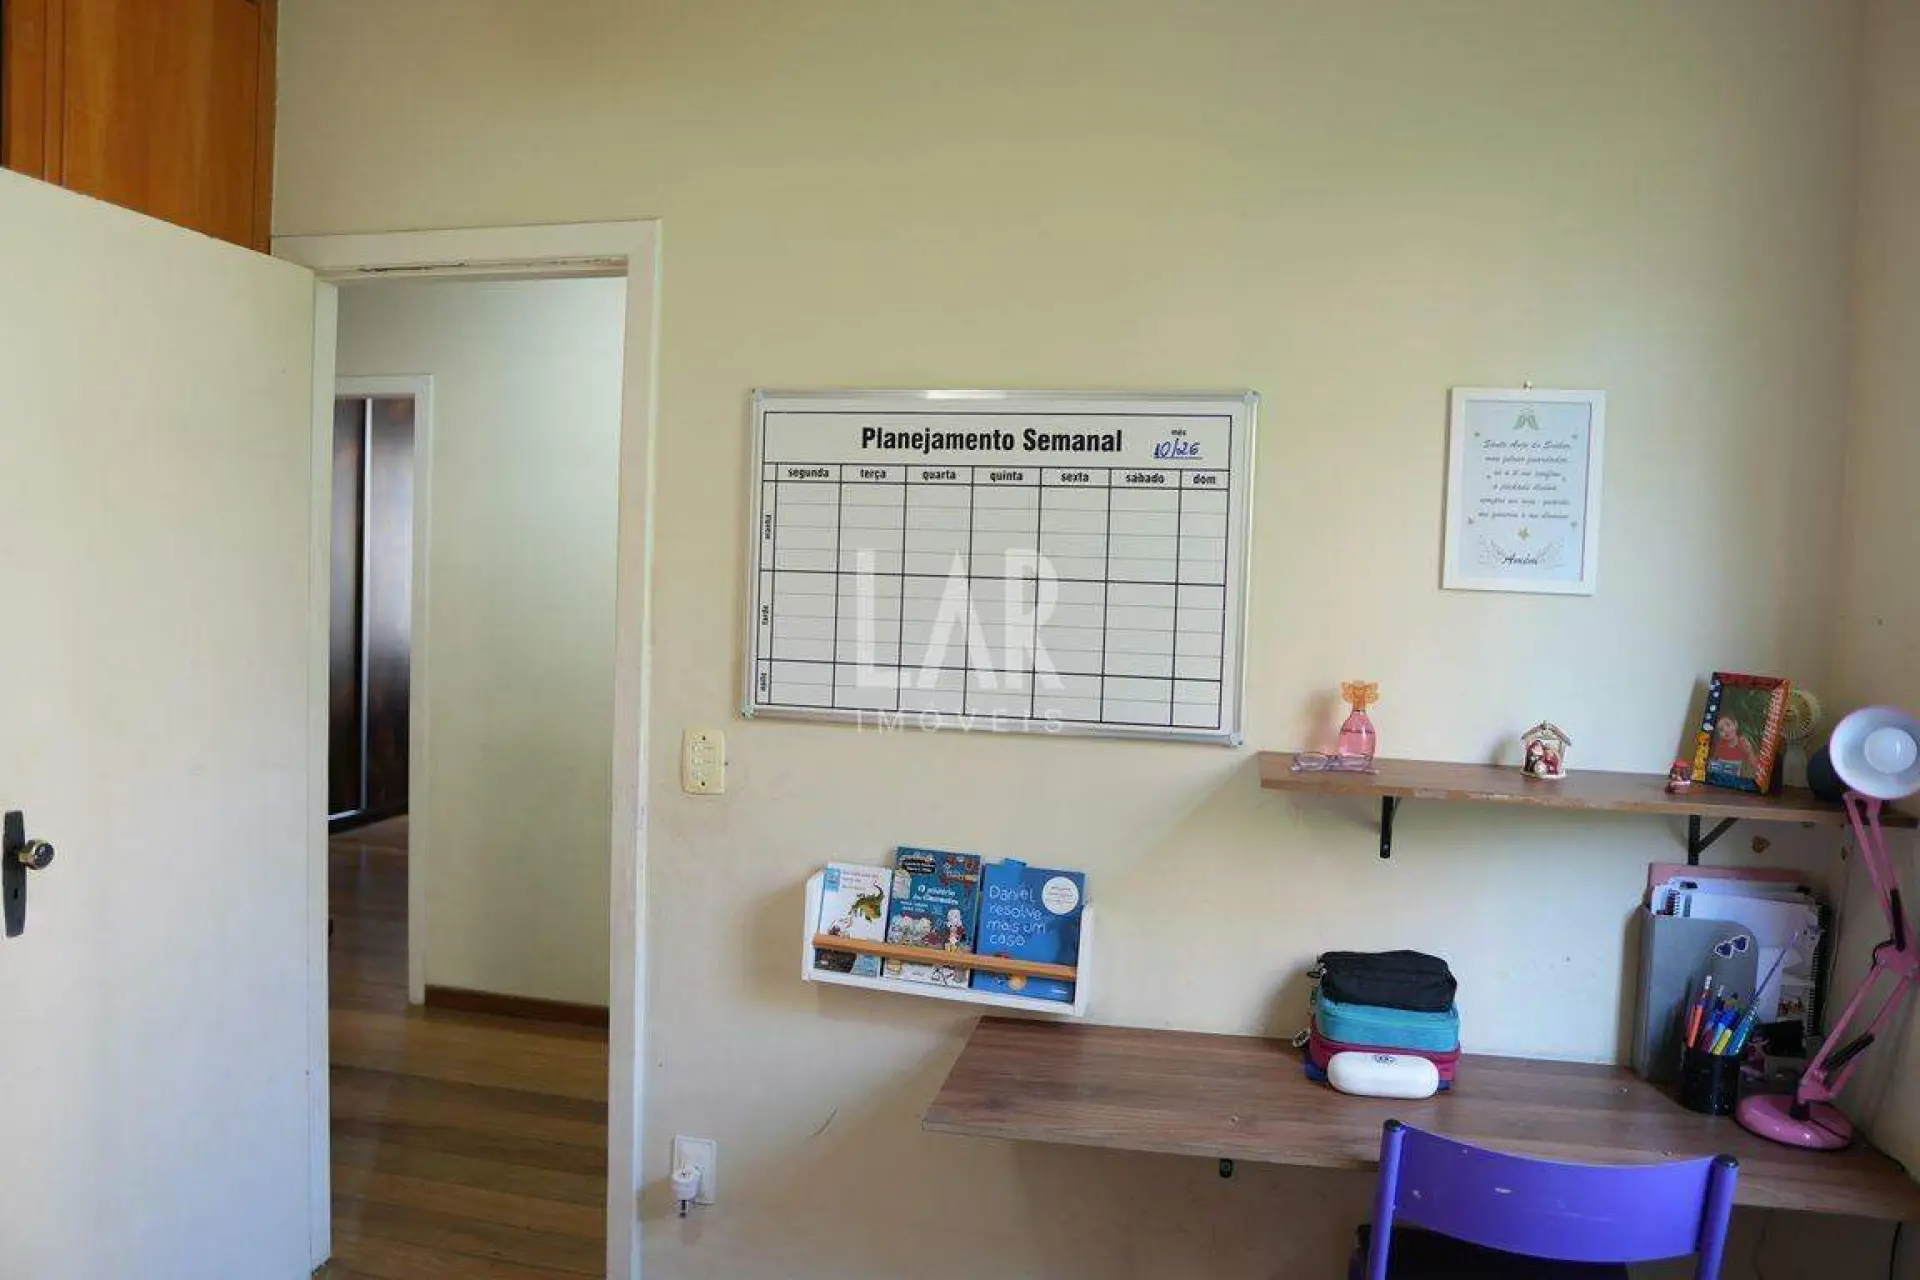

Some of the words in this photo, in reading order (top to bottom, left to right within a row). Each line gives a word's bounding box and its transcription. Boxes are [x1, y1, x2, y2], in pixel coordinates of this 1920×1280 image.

[861, 426, 1015, 455] Planejamento
[1022, 427, 1124, 453] Semanal
[787, 467, 830, 479] segunda
[859, 468, 887, 480] terça
[922, 469, 957, 481] quarta
[988, 470, 1023, 483] quinta
[1060, 472, 1089, 483] sexta
[1192, 473, 1217, 485] dom
[988, 884, 1036, 903] Daniel
[988, 902, 1043, 921] resolve
[988, 933, 1027, 948] caso
